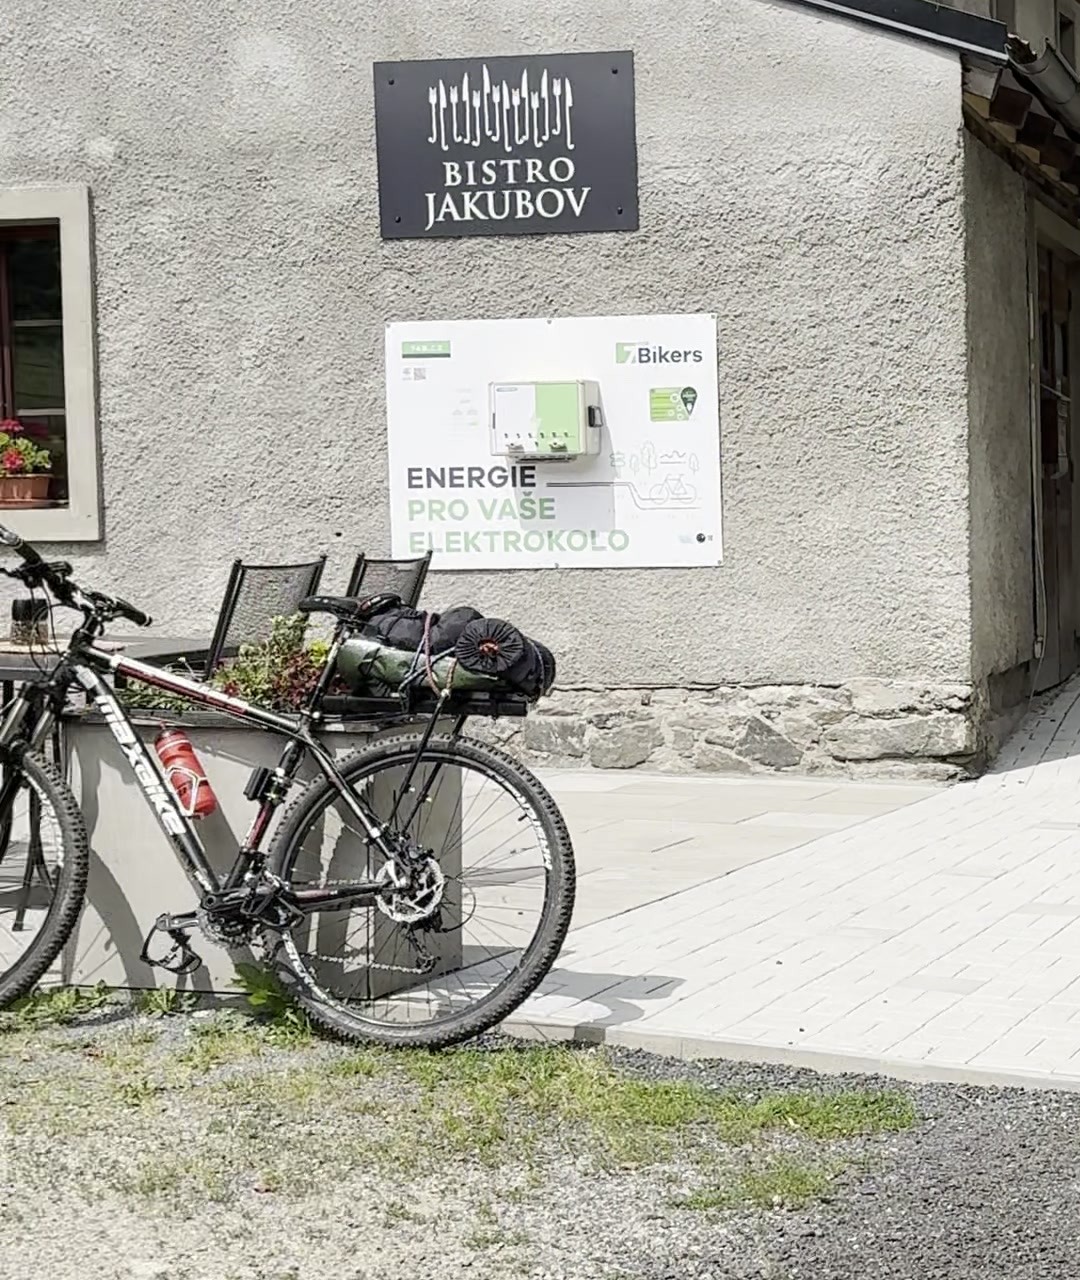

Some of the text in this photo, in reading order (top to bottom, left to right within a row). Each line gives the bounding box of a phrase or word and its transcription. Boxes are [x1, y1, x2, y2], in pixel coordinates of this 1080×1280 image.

[442, 156, 576, 187] BISTRO
[424, 186, 592, 231] JAKUBOV
[407, 465, 537, 489] ENERGIE
[408, 491, 556, 522] PRO VAŠE
[408, 529, 630, 554] ELEKTROKOLO
